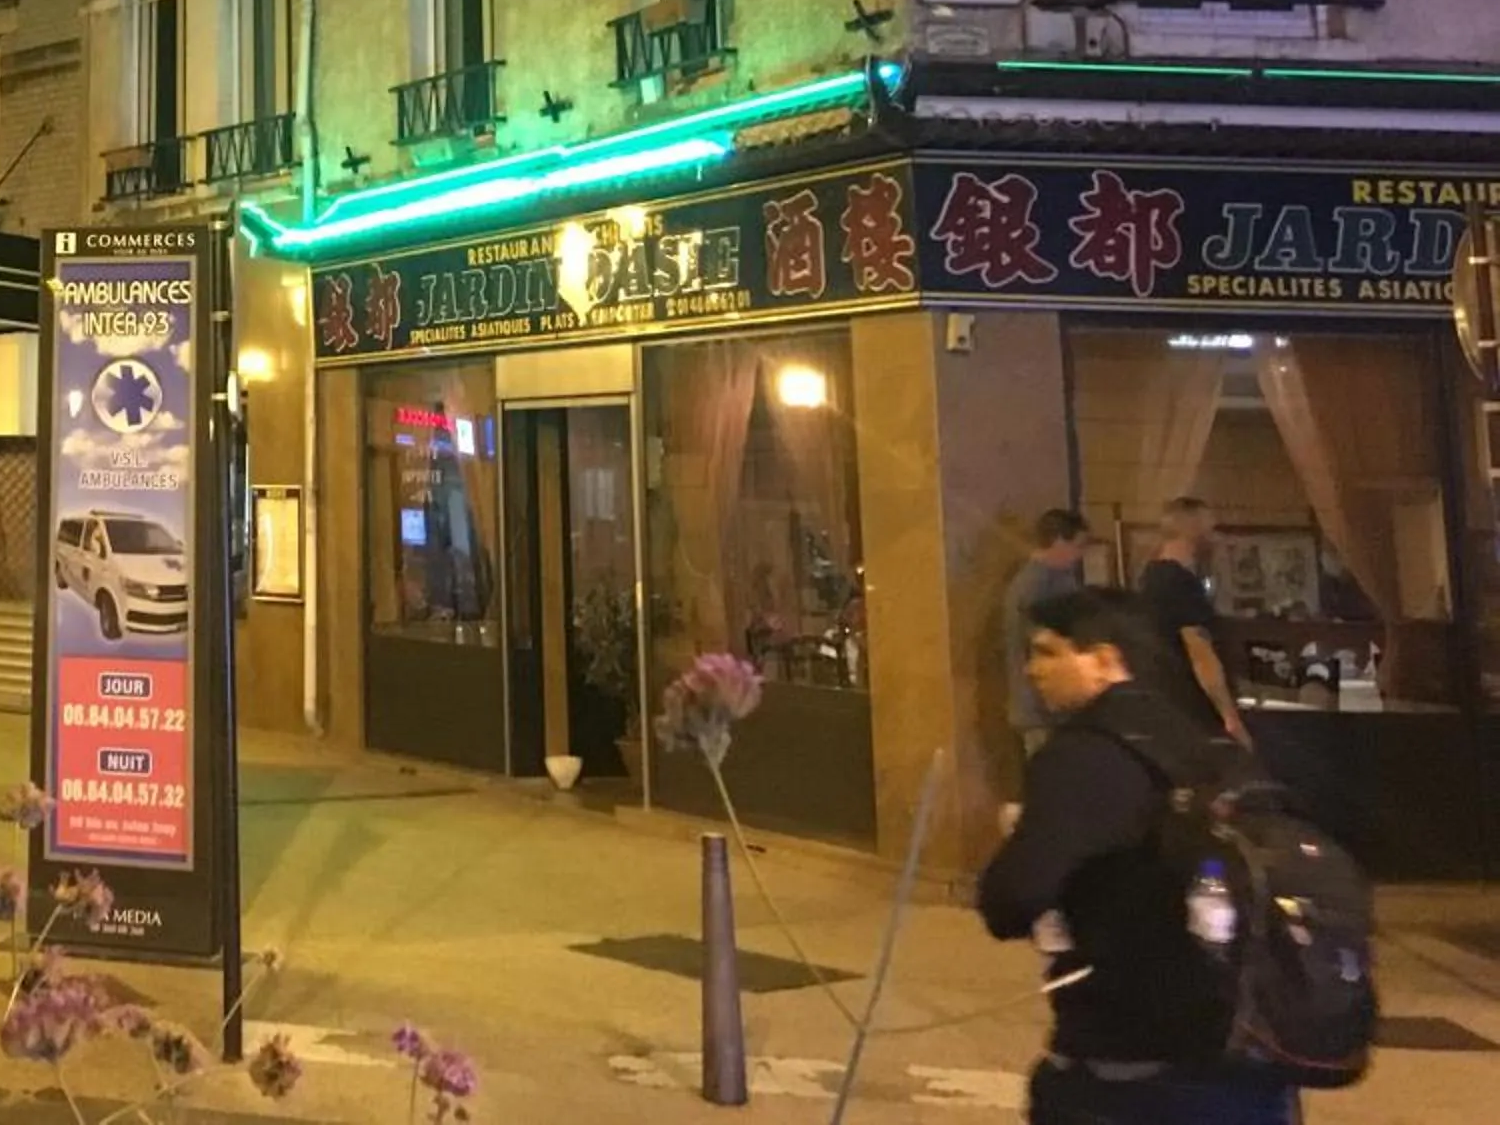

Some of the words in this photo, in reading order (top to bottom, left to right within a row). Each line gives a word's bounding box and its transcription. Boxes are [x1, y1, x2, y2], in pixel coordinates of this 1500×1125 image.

[86, 232, 196, 248] COMMERCES
[467, 235, 560, 266] RESTAURAN
[1202, 203, 1470, 276] JARD
[64, 280, 192, 305] AMBULANCES
[417, 258, 562, 326] JARDIN
[1187, 274, 1343, 298] SPECIALITES
[84, 311, 137, 335] INTER
[143, 311, 170, 335] 93
[470, 316, 531, 339] ASIATIQUES
[80, 471, 179, 489] AMBULANCES
[104, 678, 145, 695] JOUR
[106, 753, 145, 772] NUIT
[113, 908, 163, 926] MEDIA
